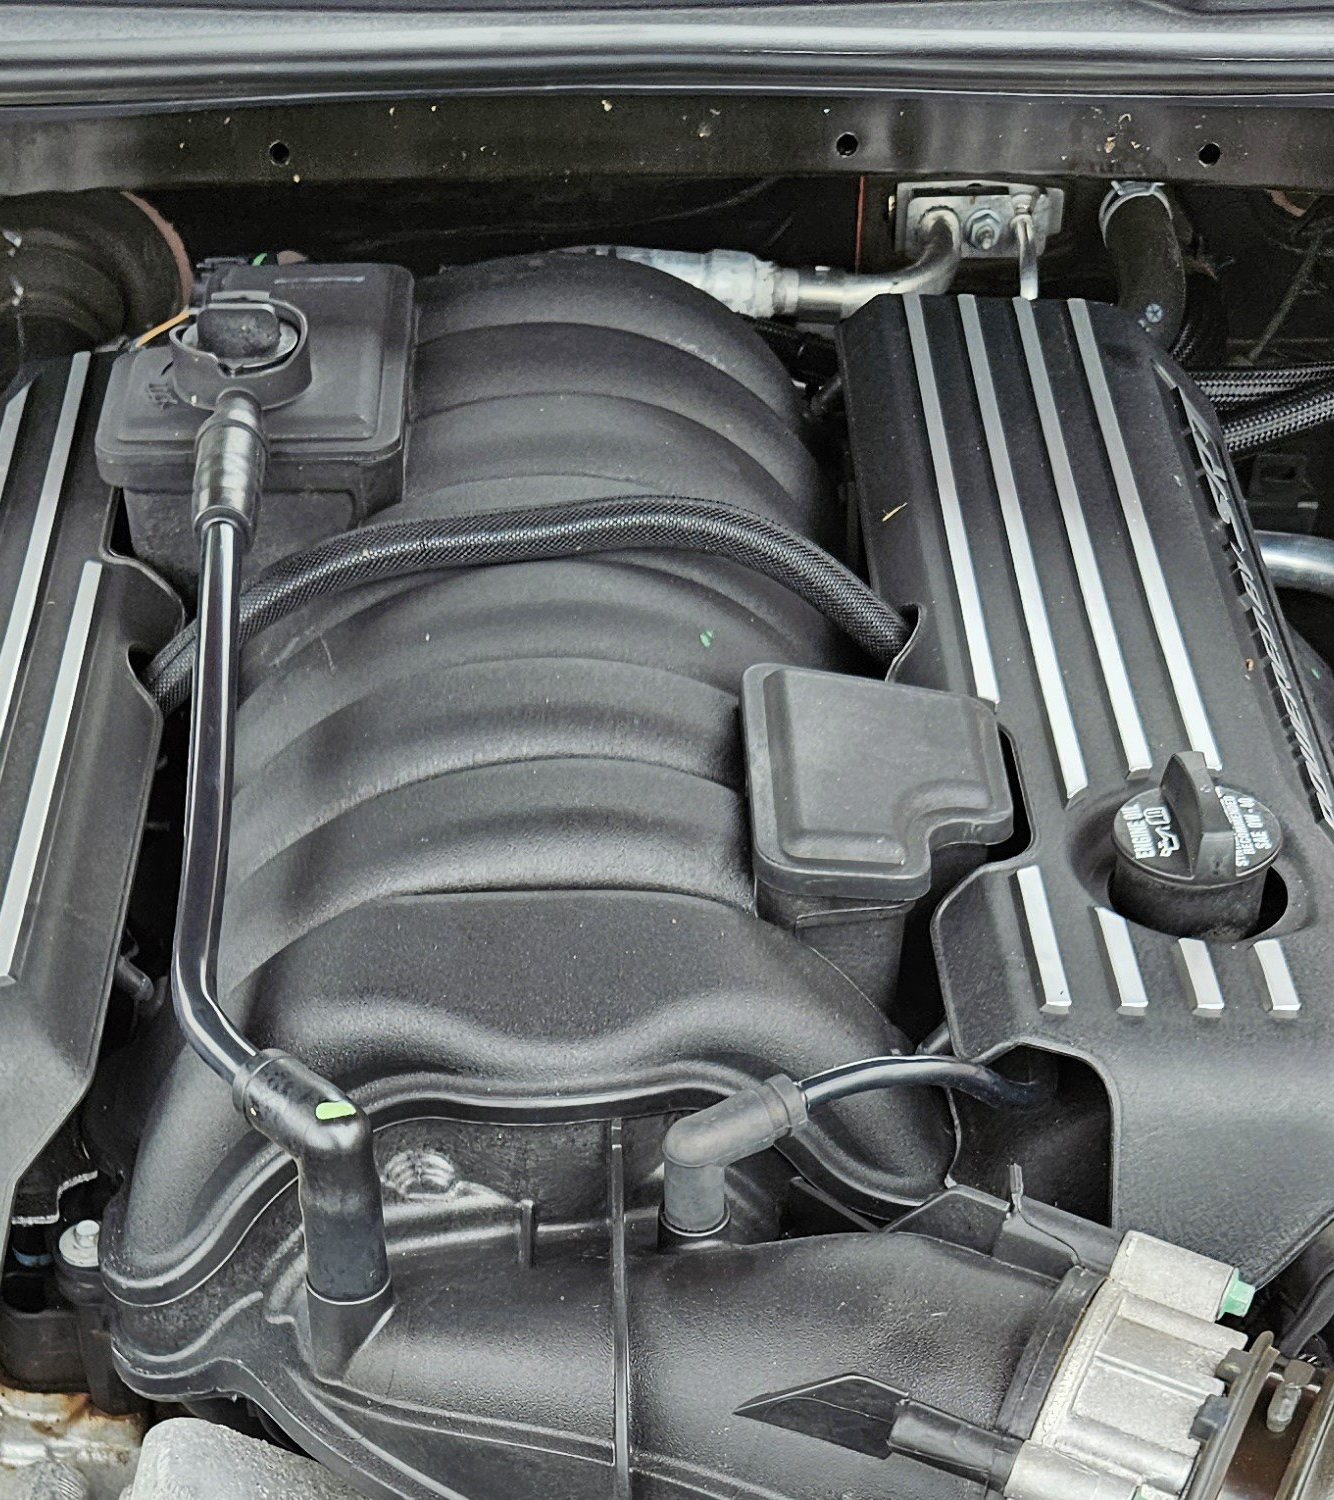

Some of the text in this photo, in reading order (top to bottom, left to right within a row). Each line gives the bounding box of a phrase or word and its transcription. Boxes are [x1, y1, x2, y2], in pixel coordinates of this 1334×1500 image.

[1120, 802, 1156, 859] ENGINE OIL
[1250, 830, 1273, 850] SAE
